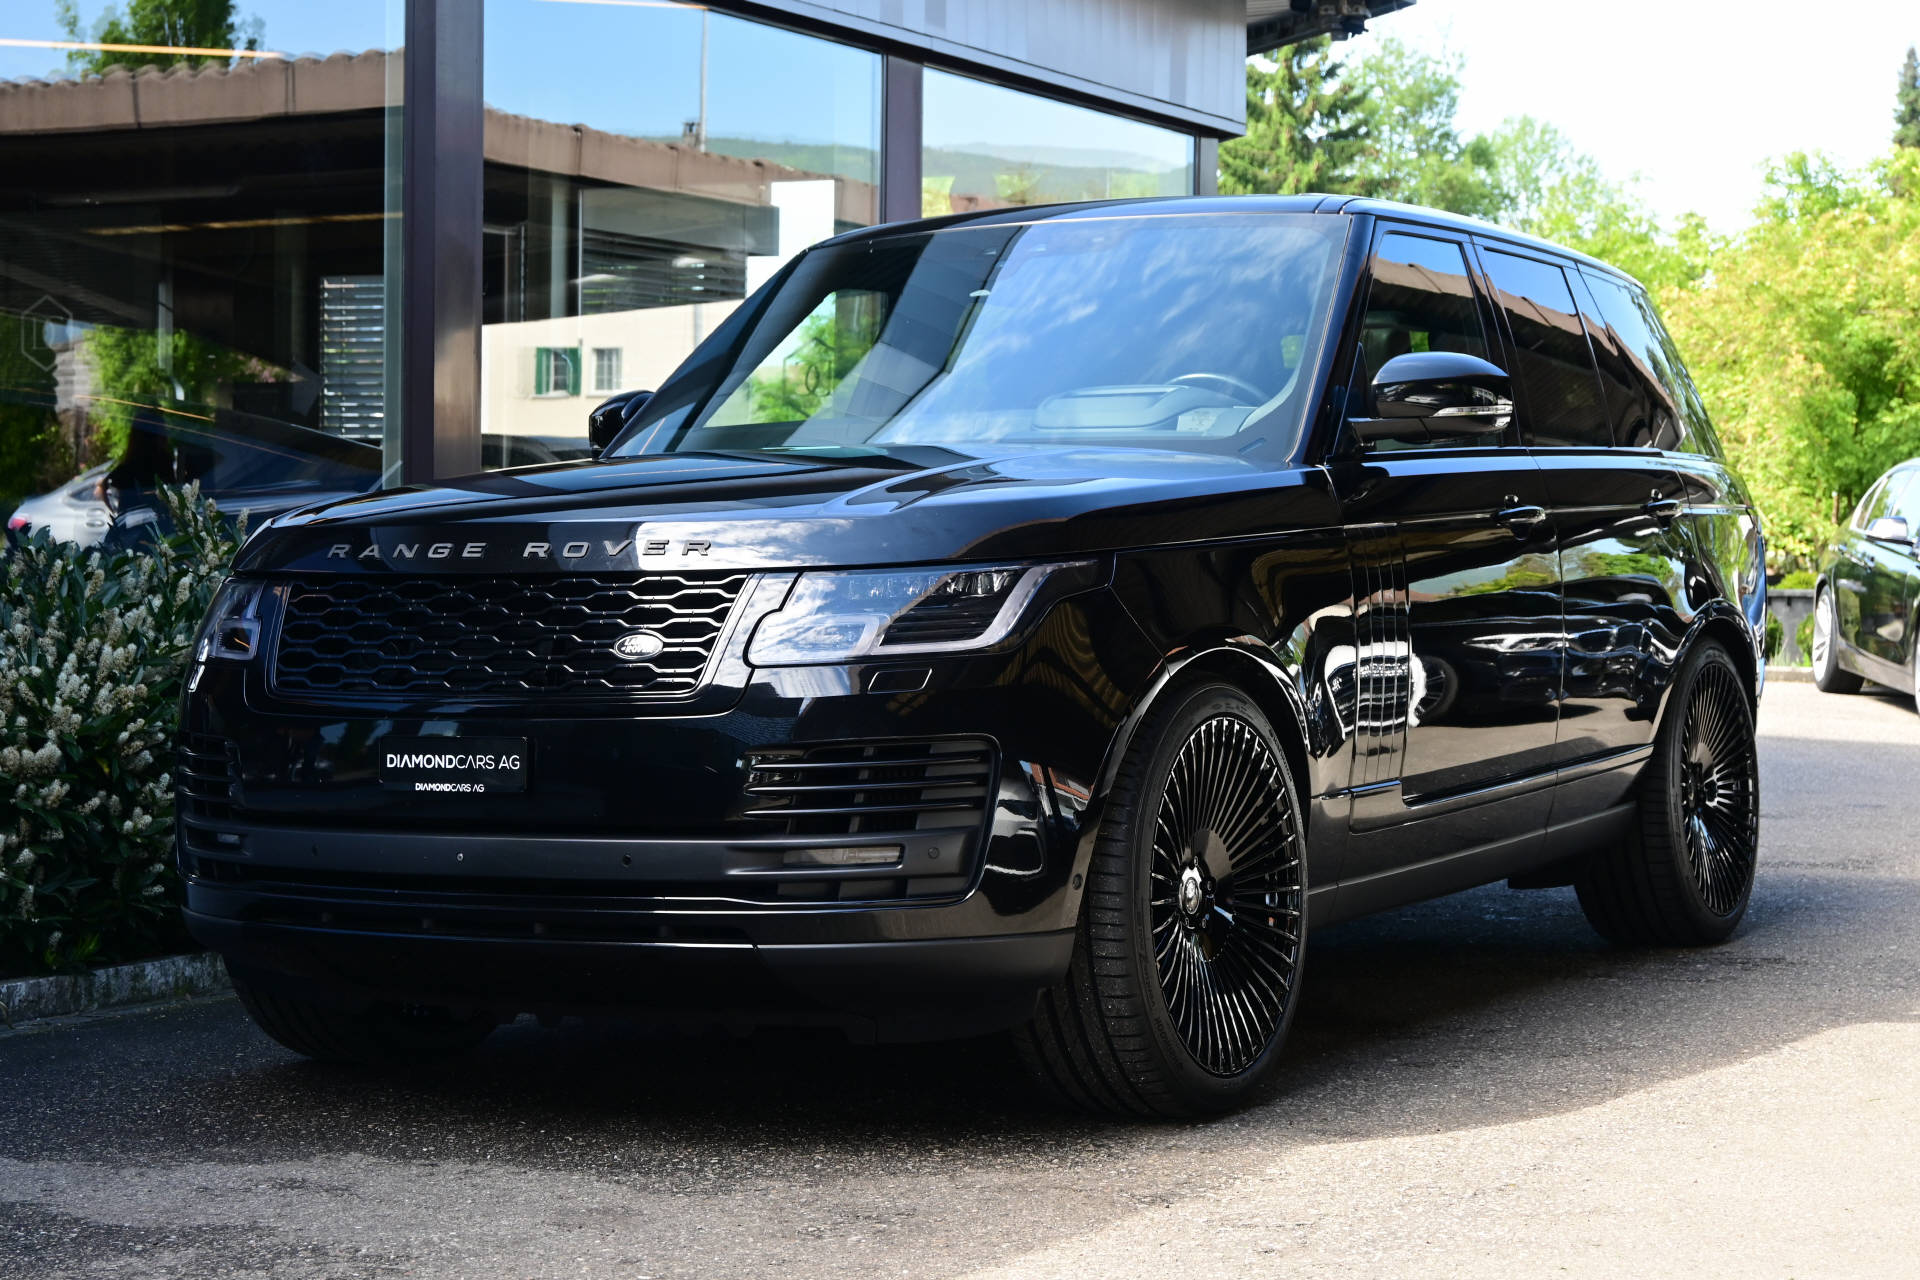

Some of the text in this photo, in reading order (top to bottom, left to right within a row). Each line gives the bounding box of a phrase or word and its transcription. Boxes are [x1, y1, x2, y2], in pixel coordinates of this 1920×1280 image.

[327, 539, 712, 559] RANGE ROVER
[386, 753, 521, 770] DIAMONDCARS AG
[415, 782, 485, 793] DIAMONDCARS AG
